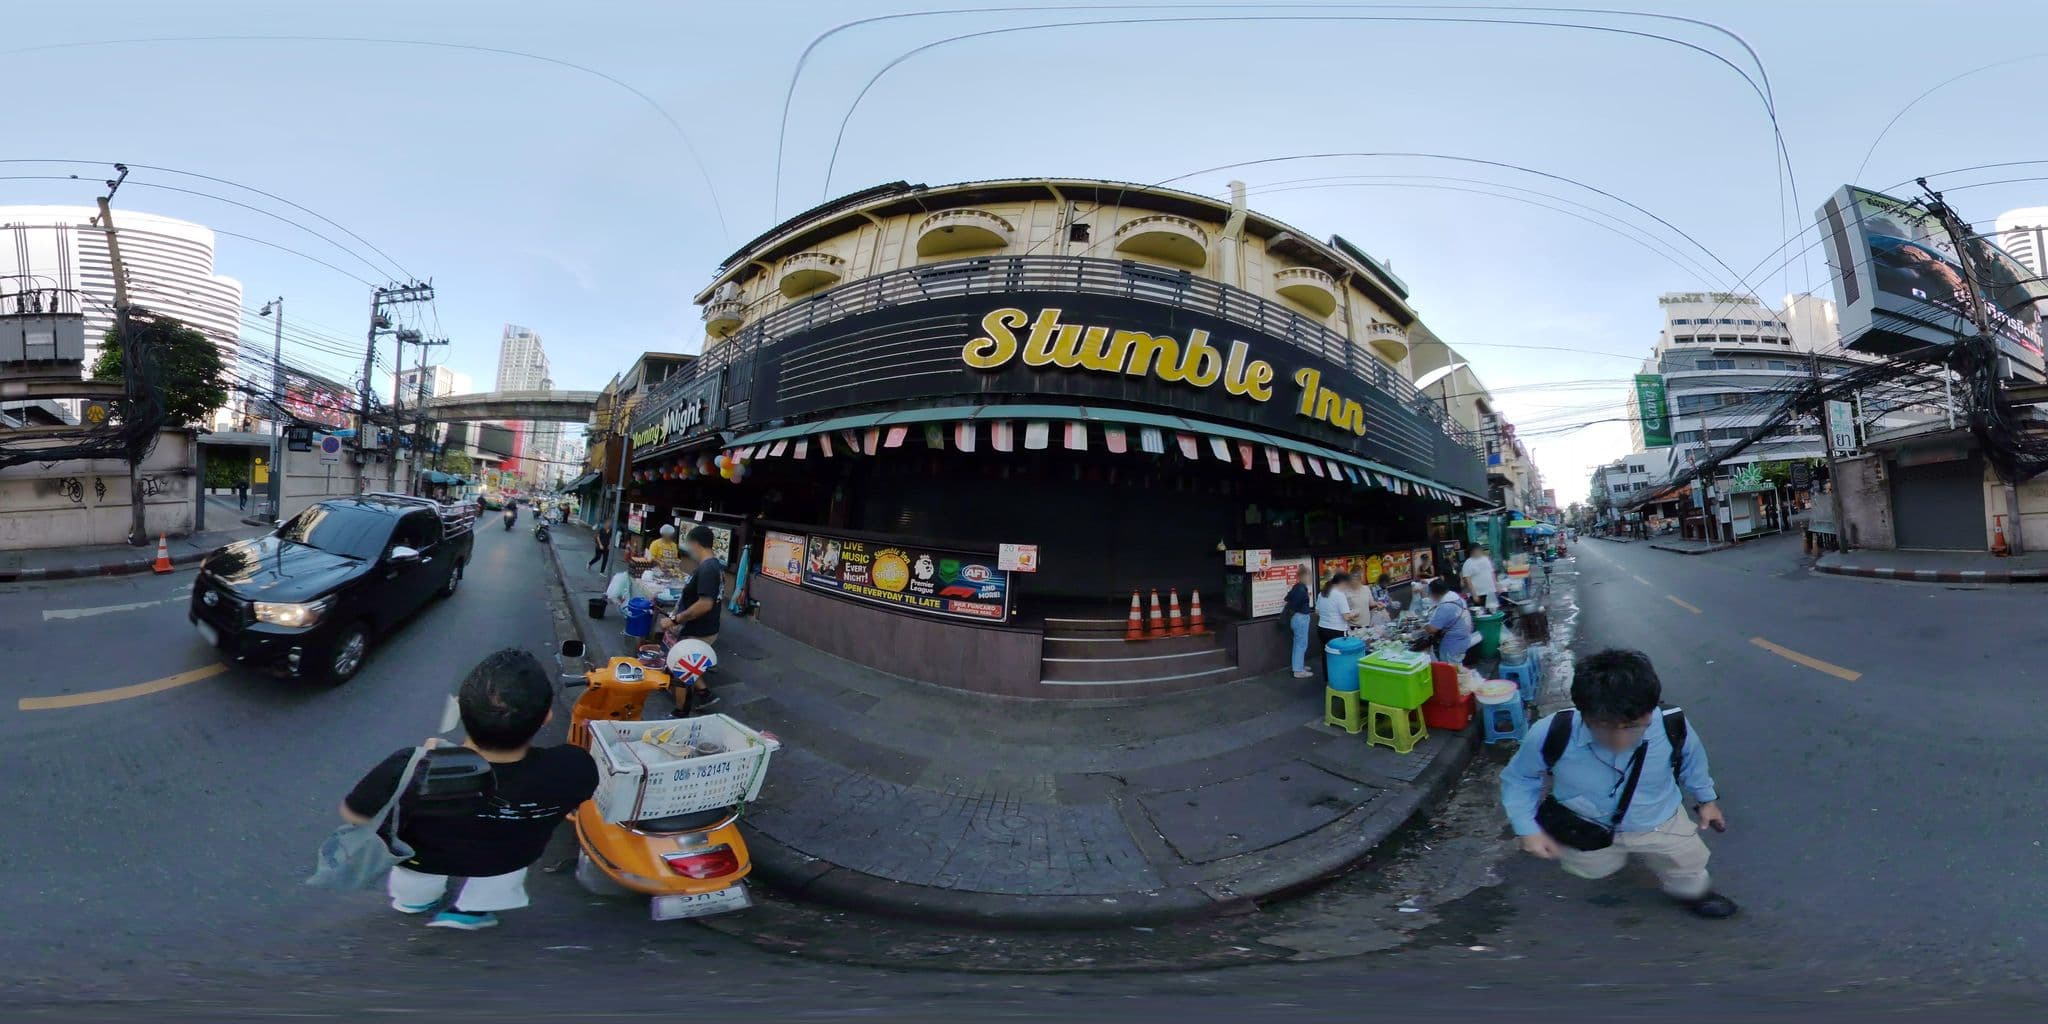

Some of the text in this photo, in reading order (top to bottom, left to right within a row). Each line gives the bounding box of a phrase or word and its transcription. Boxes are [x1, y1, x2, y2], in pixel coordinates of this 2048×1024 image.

[962, 307, 1367, 437] Stumble Inn
[632, 399, 702, 450] Morning Night
[843, 541, 864, 551] LIVE
[841, 551, 870, 564] MUSIC
[845, 562, 867, 573] EVERY
[843, 572, 869, 583] NIGHT!
[965, 568, 989, 579] AFL
[910, 578, 934, 588] Premier
[910, 584, 934, 595] League
[843, 583, 941, 608] OPEN EVERYDAY TIL LATE
[978, 591, 1001, 600] MORE!
